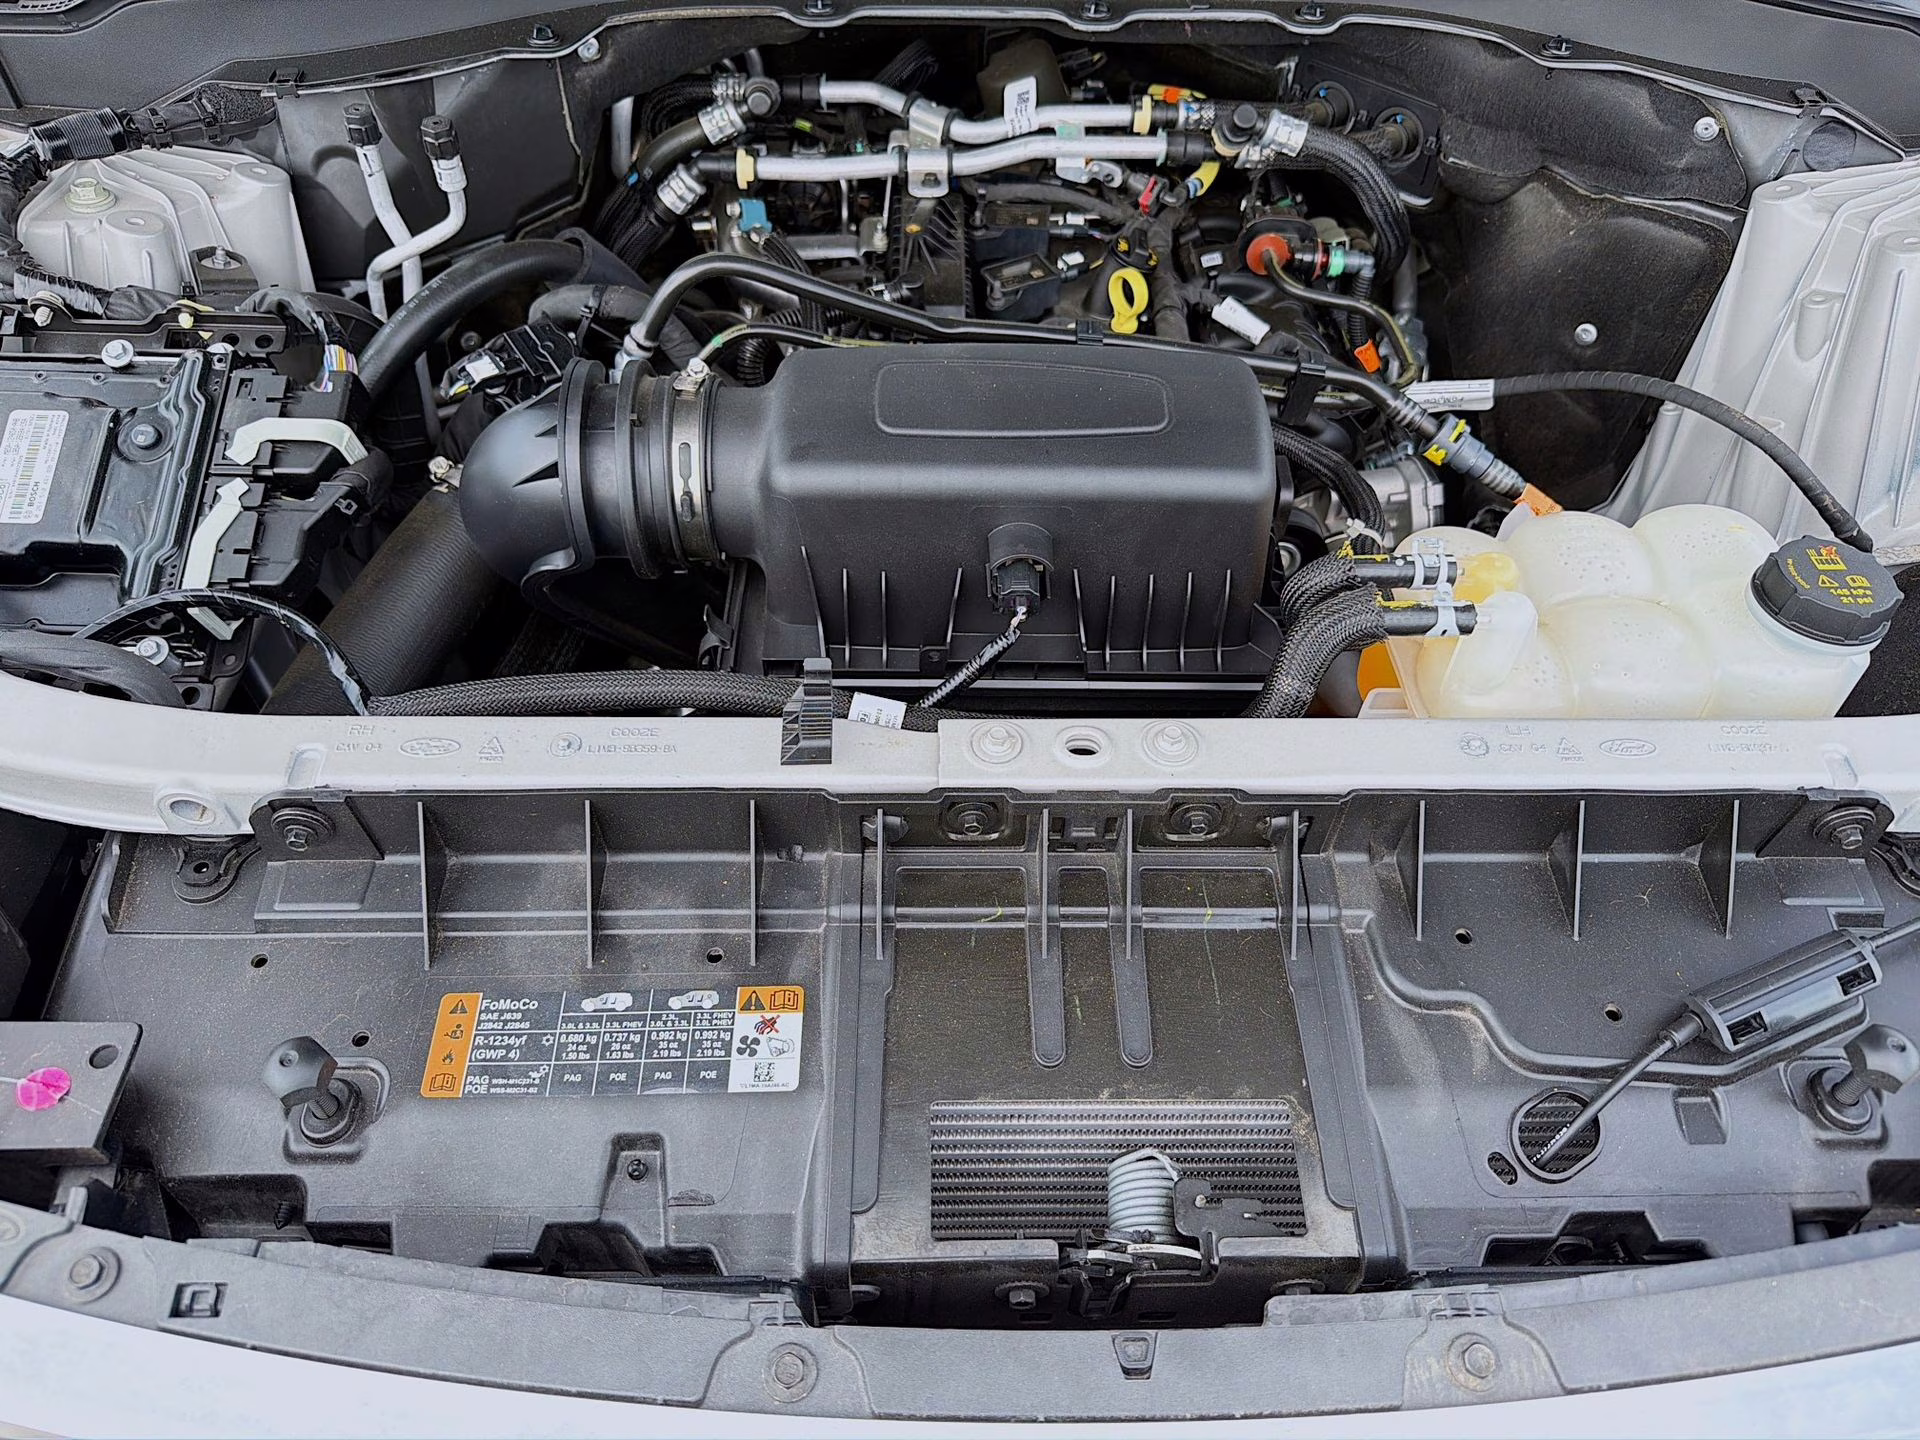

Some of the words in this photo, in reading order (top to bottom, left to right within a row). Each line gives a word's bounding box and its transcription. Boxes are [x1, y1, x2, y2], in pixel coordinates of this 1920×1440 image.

[27, 481, 40, 507] BOSCH
[481, 998, 539, 1011] FoMoCo
[480, 1012, 500, 1020] SAE
[500, 1012, 523, 1020] J639
[712, 1011, 734, 1019] FHEV
[477, 1022, 504, 1030] J2842
[503, 1021, 531, 1030] J2845
[622, 1020, 644, 1028] FHEV
[711, 1018, 733, 1026] PHEV
[560, 1033, 585, 1043] 0.680
[585, 1033, 598, 1045] kg
[603, 1032, 629, 1042] 0.737
[629, 1032, 642, 1043] kg
[651, 1031, 675, 1041] 0.992
[676, 1030, 689, 1042] kg
[694, 1030, 719, 1040] 0.992
[719, 1029, 732, 1041] kg
[474, 1034, 528, 1048] R-1234yf
[658, 1040, 668, 1049] 35
[668, 1041, 679, 1049] oz
[701, 1040, 712, 1048] 35
[566, 1043, 577, 1052] 24
[610, 1042, 621, 1051] 26
[471, 1048, 507, 1061] (GWP
[507, 1048, 520, 1061] 4)
[561, 1052, 578, 1061] 1.50
[578, 1051, 591, 1060] lbs
[605, 1051, 622, 1059] 1.63
[622, 1051, 635, 1059] lbs
[652, 1049, 669, 1058] 2.19
[669, 1049, 682, 1058] lbs
[696, 1049, 713, 1057] 2.19
[713, 1048, 726, 1057] lbs
[563, 1073, 583, 1082] PAG
[609, 1072, 628, 1081] POE
[654, 1071, 673, 1080] PAG
[699, 1070, 718, 1079] POE
[465, 1075, 490, 1085] PAG
[464, 1084, 489, 1094] POE
